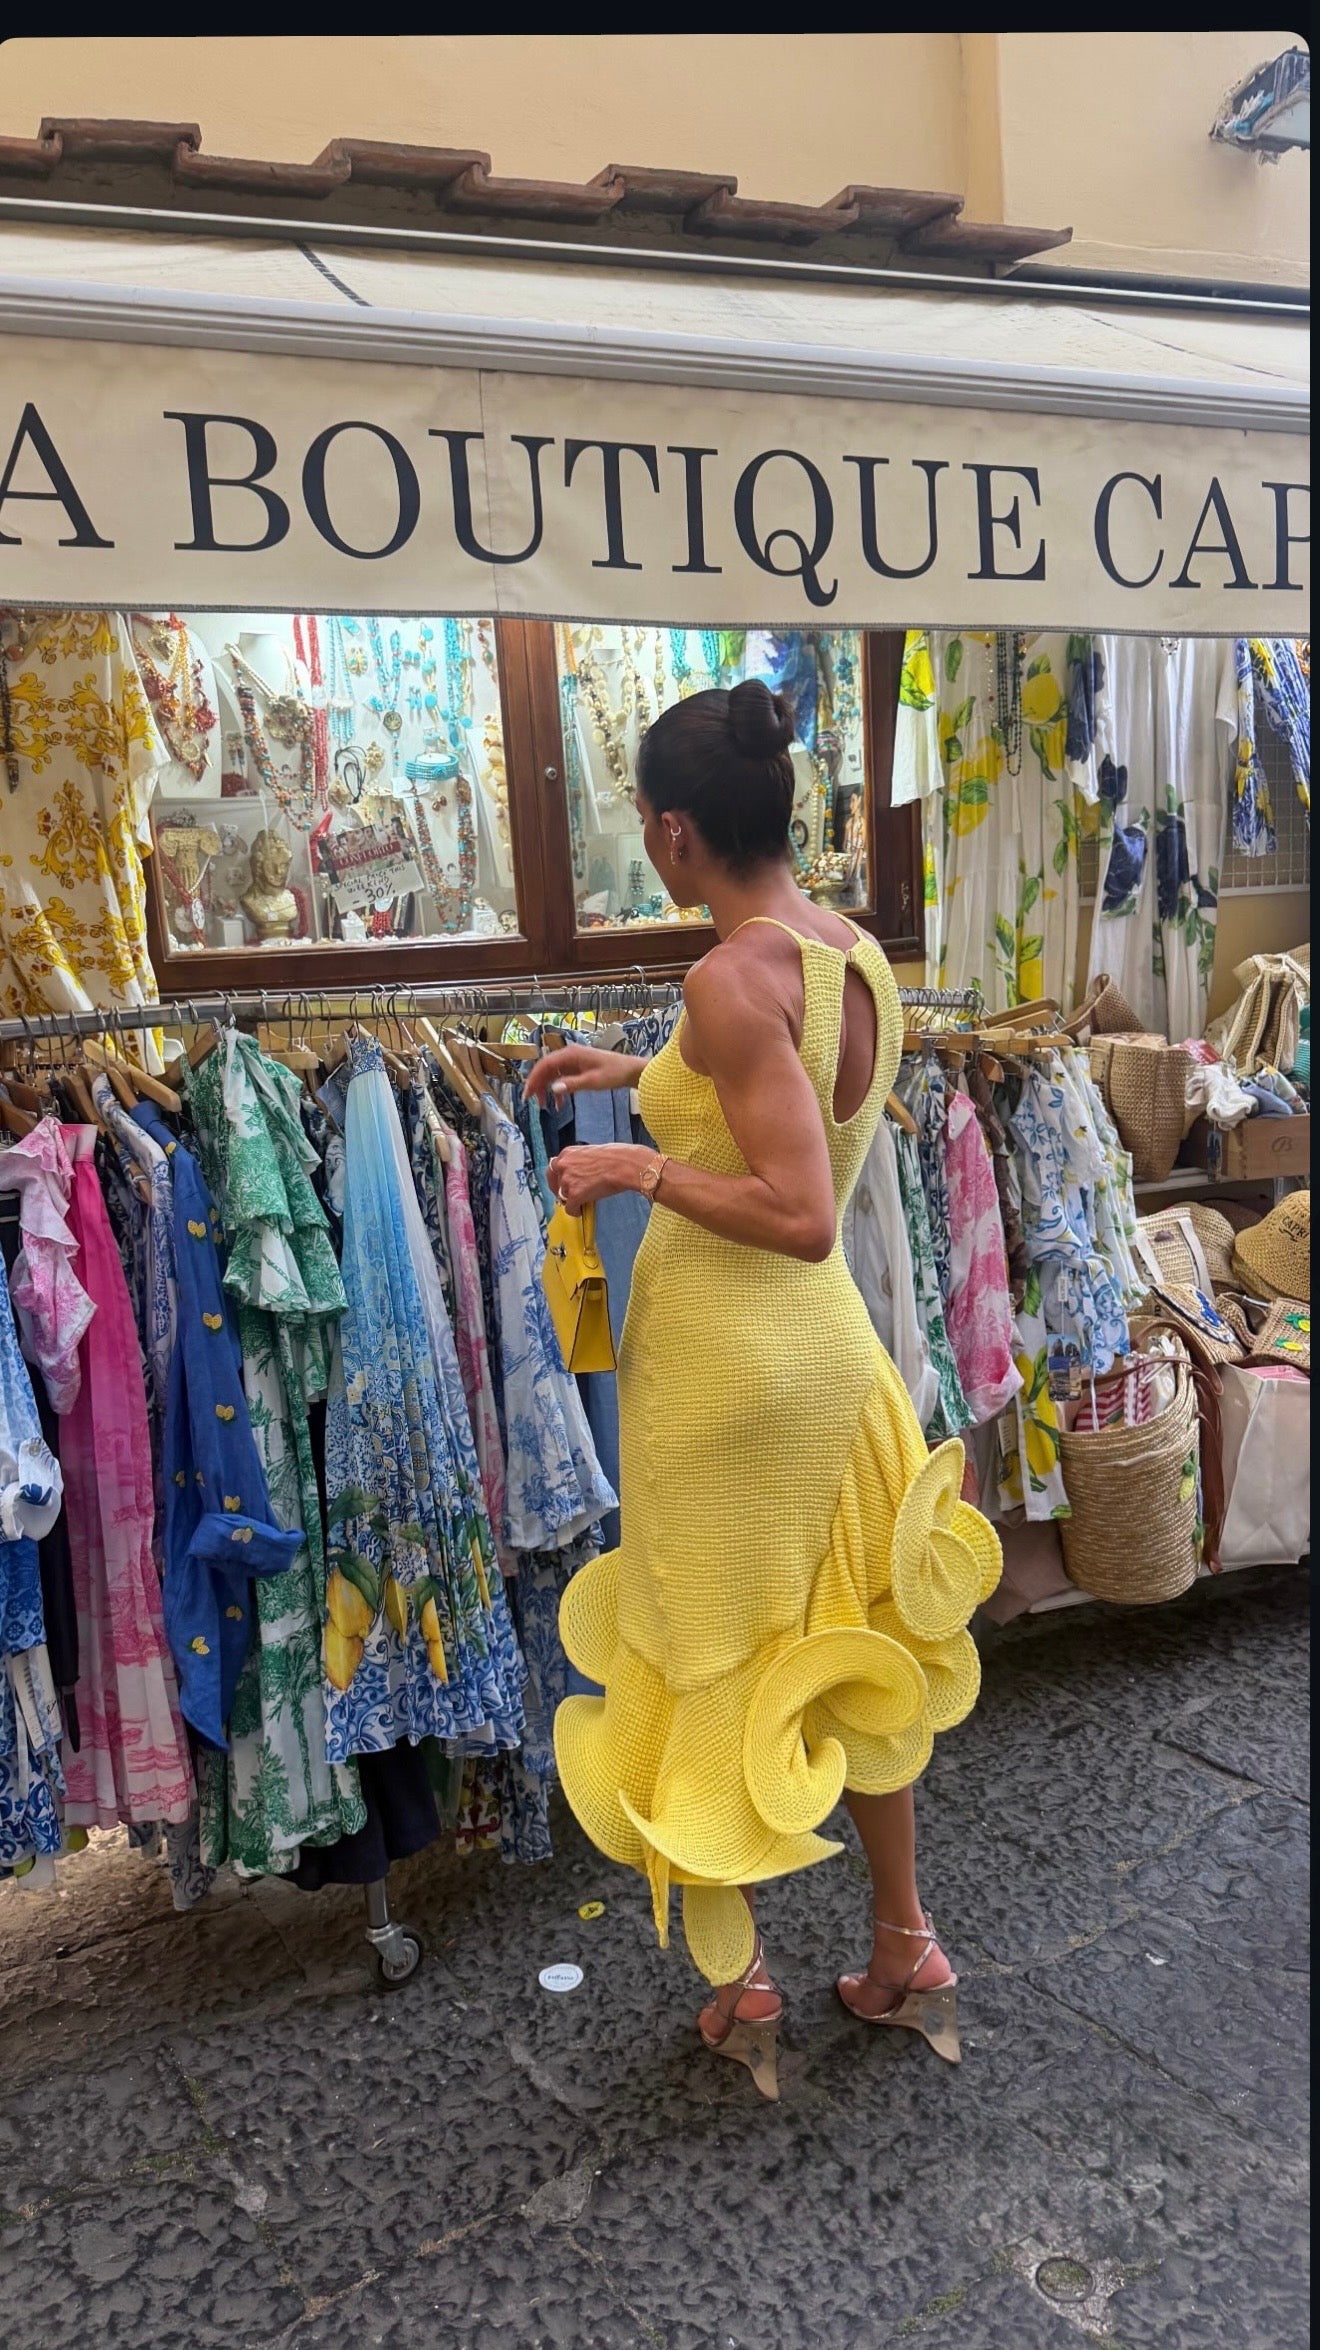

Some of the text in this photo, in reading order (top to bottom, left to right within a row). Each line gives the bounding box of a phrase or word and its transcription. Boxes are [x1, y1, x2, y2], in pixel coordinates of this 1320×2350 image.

[163, 411, 1047, 607] BOUTIQUE
[1094, 471, 1310, 591] CAP
[1282, 1215, 1310, 1239] CAPRI
